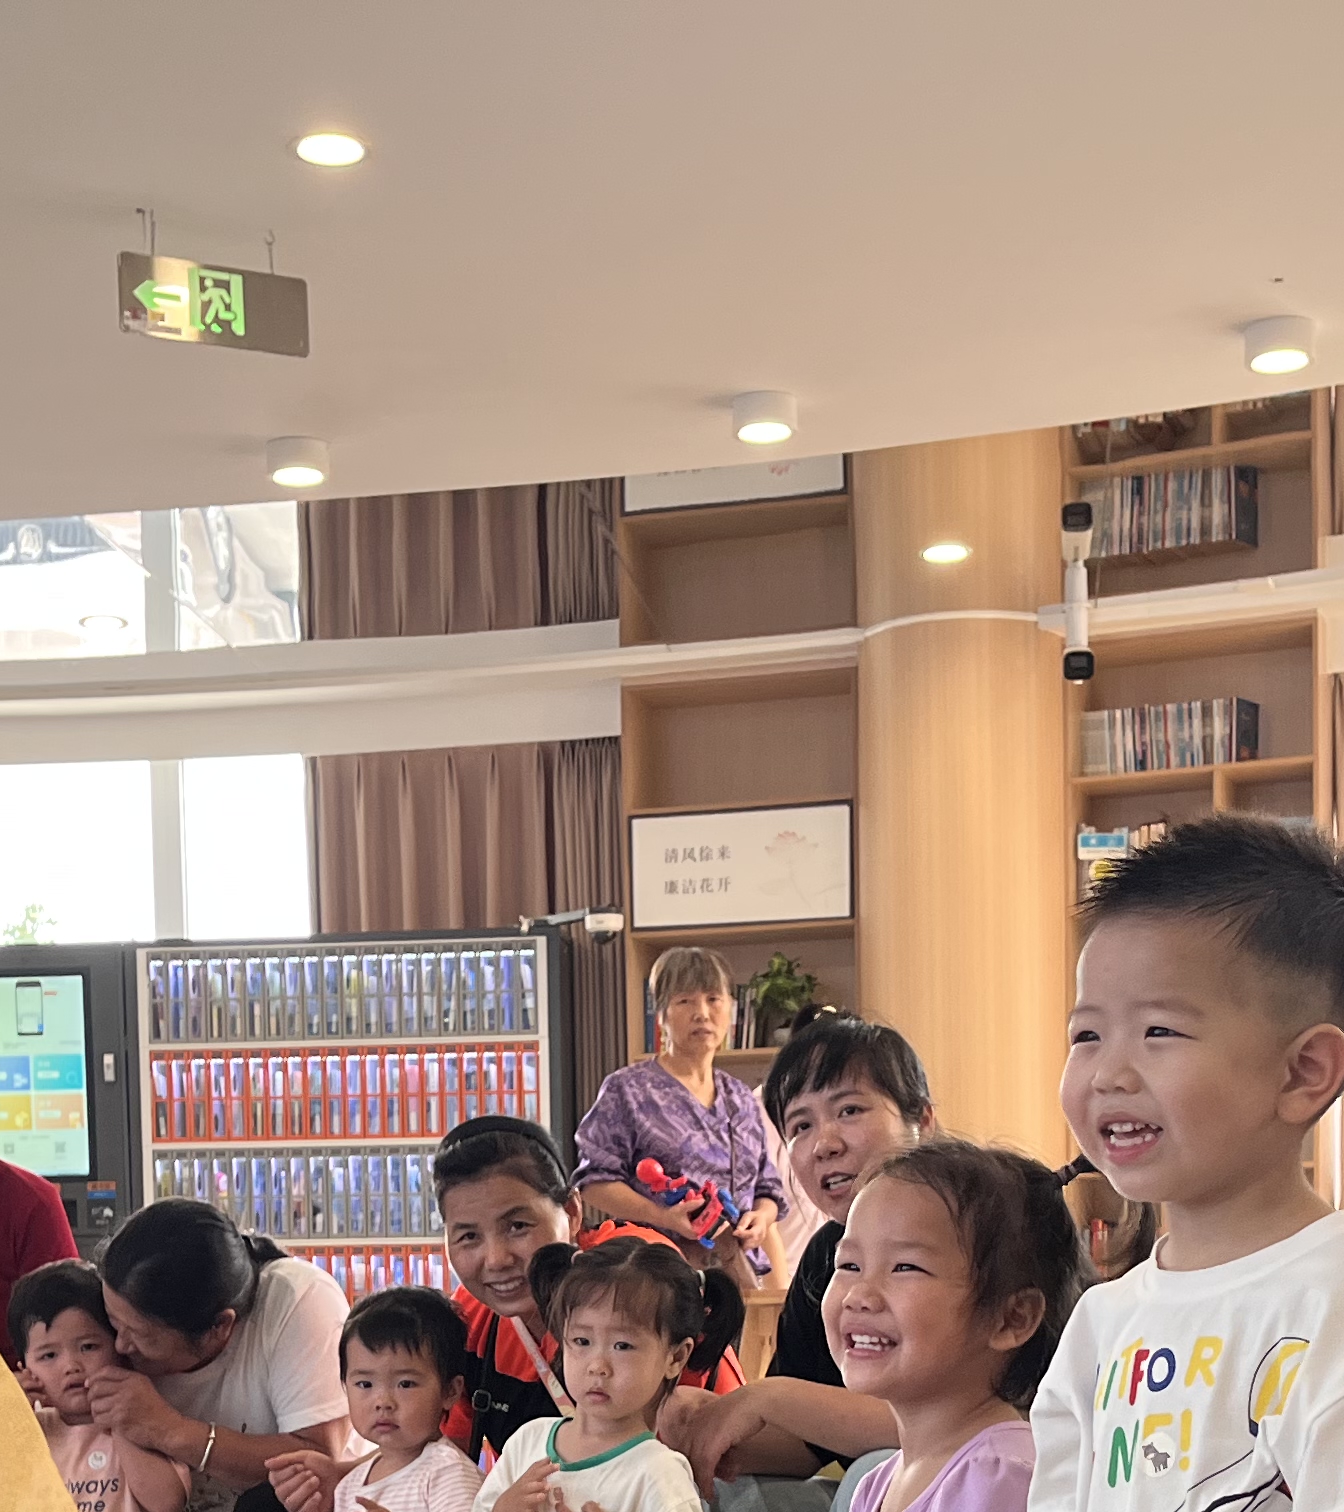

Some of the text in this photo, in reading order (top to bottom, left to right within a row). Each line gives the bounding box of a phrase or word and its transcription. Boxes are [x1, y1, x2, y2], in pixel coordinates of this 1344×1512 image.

[664, 845, 731, 863] 清风徐来
[664, 876, 731, 895] 廉洁花开
[64, 1478, 119, 1497] lways
